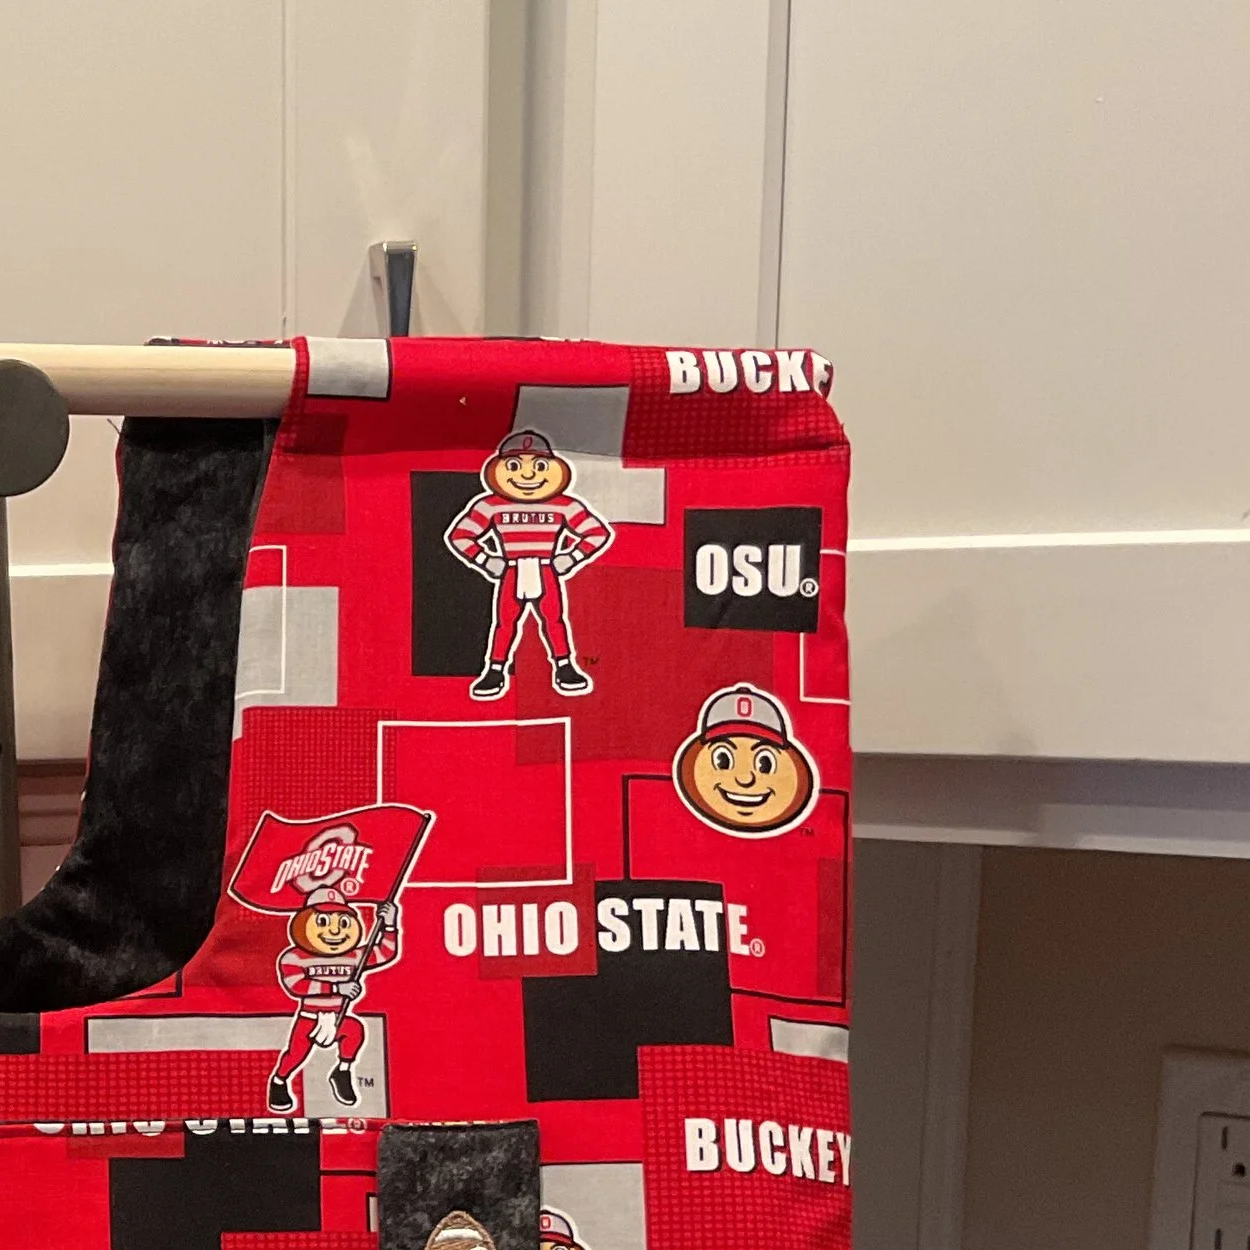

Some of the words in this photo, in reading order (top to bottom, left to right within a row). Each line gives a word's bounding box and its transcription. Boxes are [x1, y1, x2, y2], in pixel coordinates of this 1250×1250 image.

[502, 513, 555, 523] BRUTUS
[696, 545, 801, 596] OSU
[444, 902, 578, 956] OHIO
[598, 898, 749, 955] STATE
[358, 1077, 374, 1087] TM
